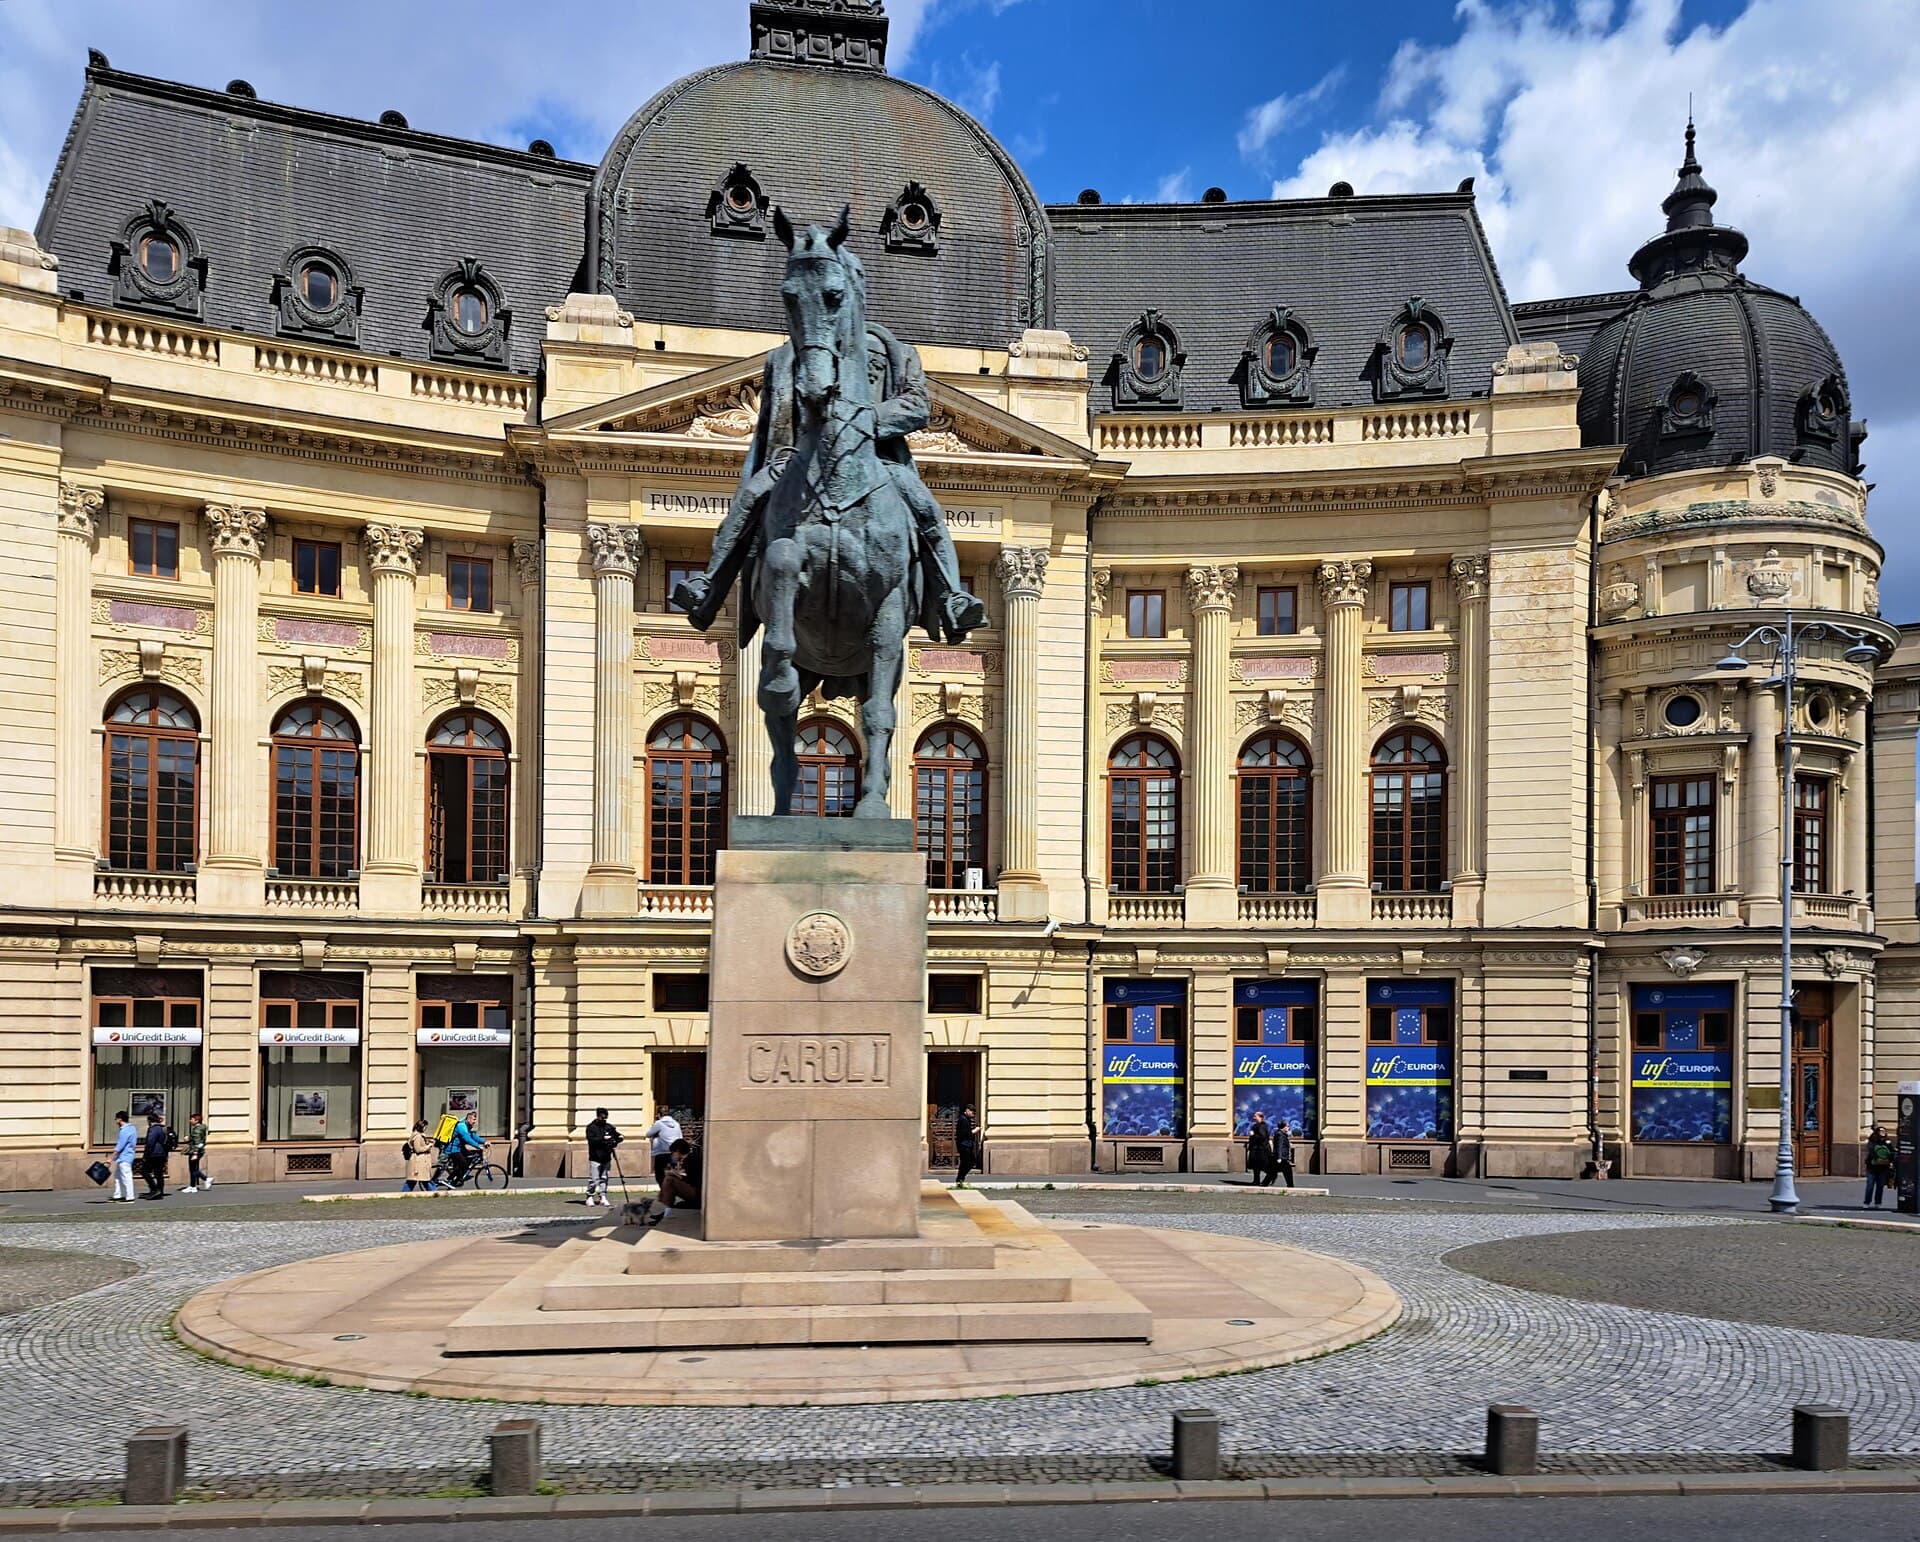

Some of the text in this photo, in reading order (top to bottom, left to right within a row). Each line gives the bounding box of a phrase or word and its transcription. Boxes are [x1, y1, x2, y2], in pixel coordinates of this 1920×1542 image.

[945, 510, 981, 528] ROL
[121, 1032, 187, 1041] UniCredit Bank
[285, 1033, 346, 1041] UniCredit Bank
[441, 1033, 498, 1042] UniCredit Bank
[748, 1039, 887, 1083] CAROL I
